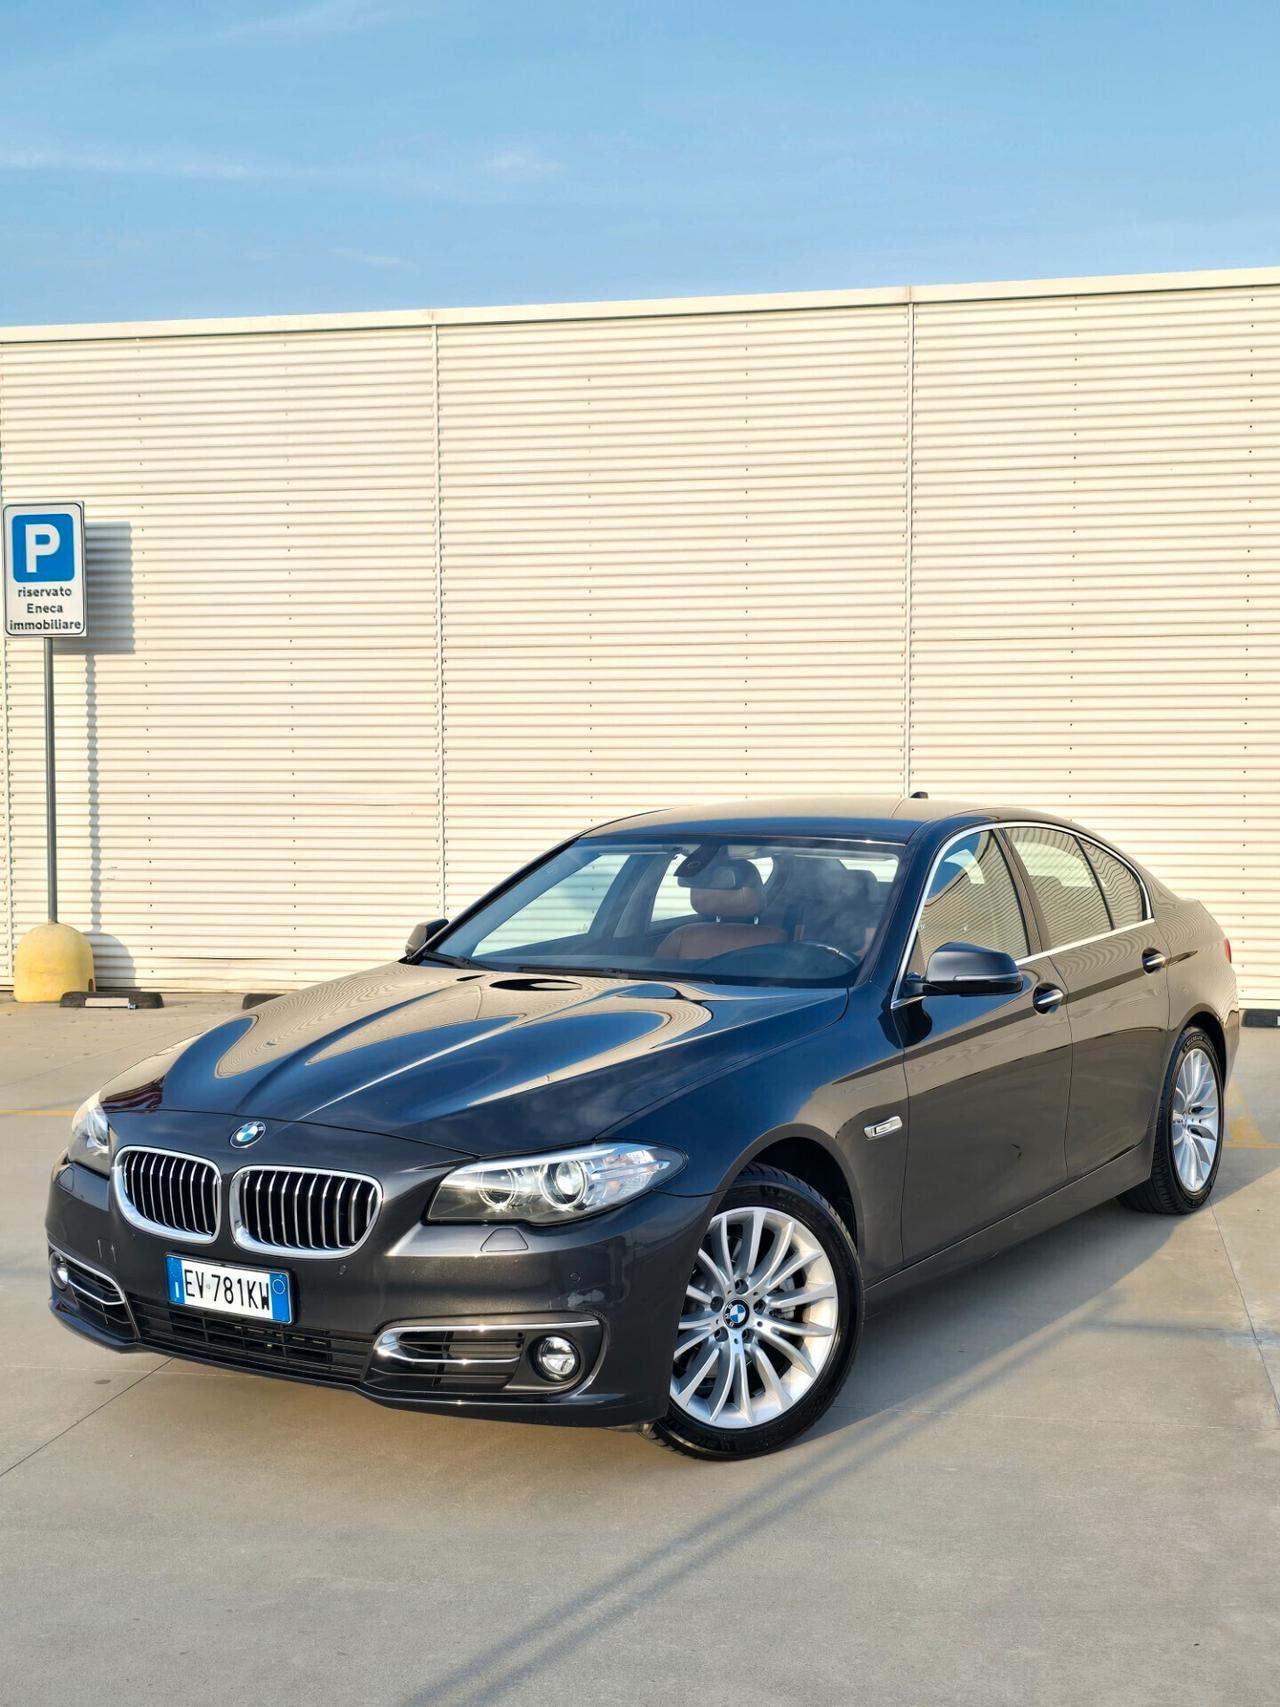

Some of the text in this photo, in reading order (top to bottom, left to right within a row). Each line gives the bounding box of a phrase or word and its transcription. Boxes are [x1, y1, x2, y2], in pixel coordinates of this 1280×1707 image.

[25, 523, 60, 573] P
[17, 586, 73, 597] riservato
[26, 603, 64, 614] Eneca
[9, 619, 82, 630] immobiliare
